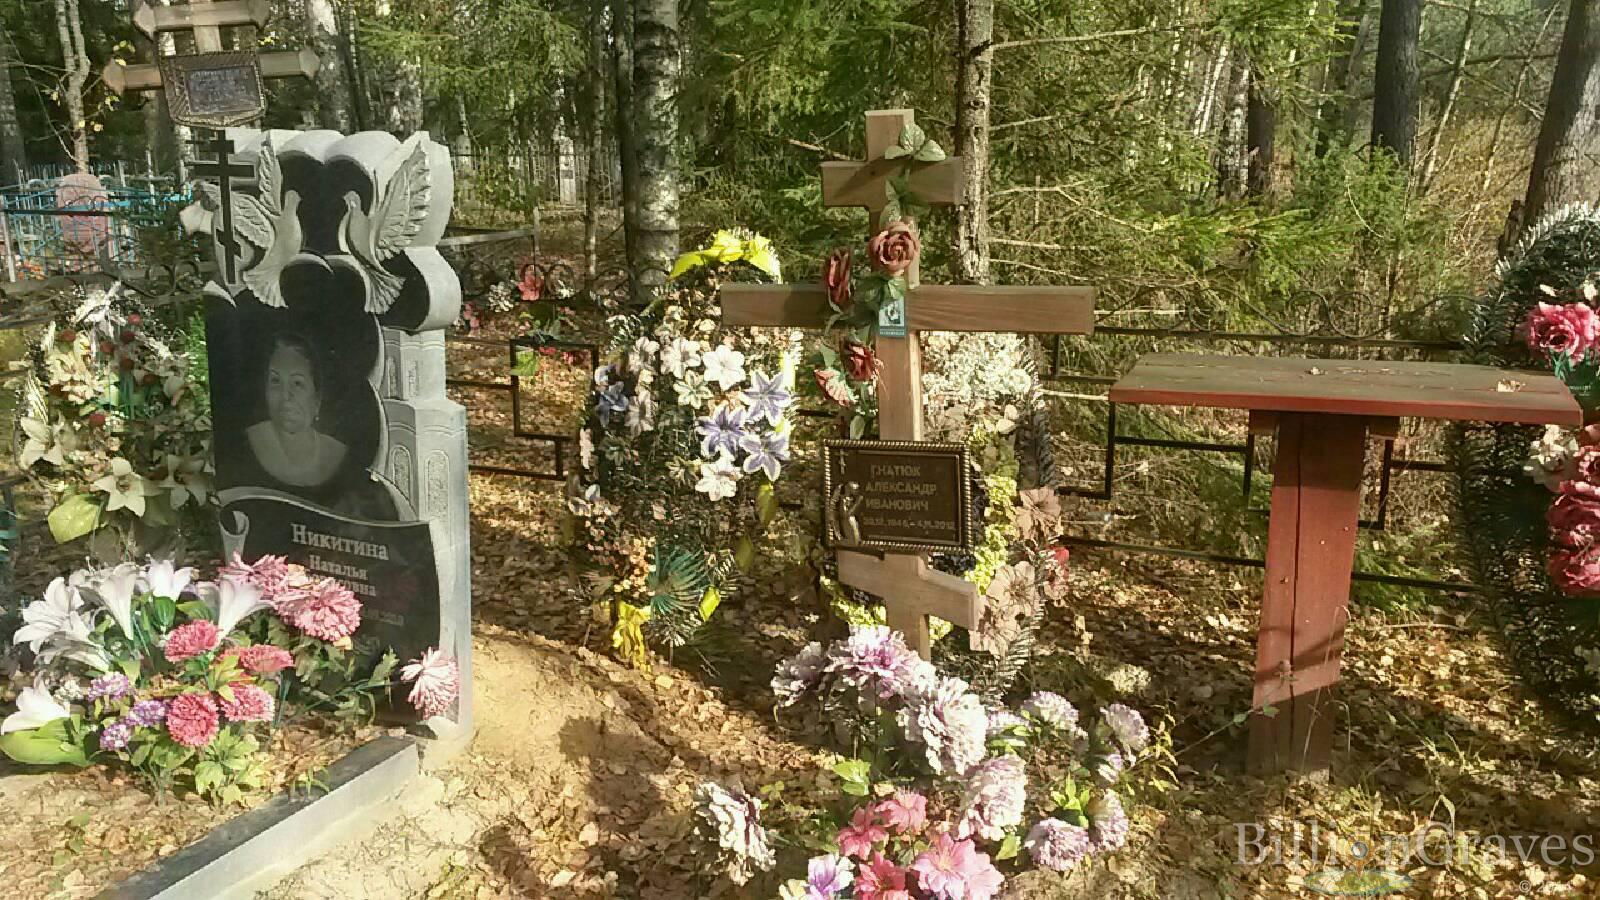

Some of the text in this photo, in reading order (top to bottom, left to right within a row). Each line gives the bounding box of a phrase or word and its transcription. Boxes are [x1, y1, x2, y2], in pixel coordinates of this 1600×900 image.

[870, 464, 921, 479] ГНАТЮК
[865, 481, 937, 496] АЛЕКСАНДР
[865, 498, 930, 512] ИВАНОВИЧ
[290, 523, 389, 561] Никитина
[309, 555, 369, 581] Наталья
